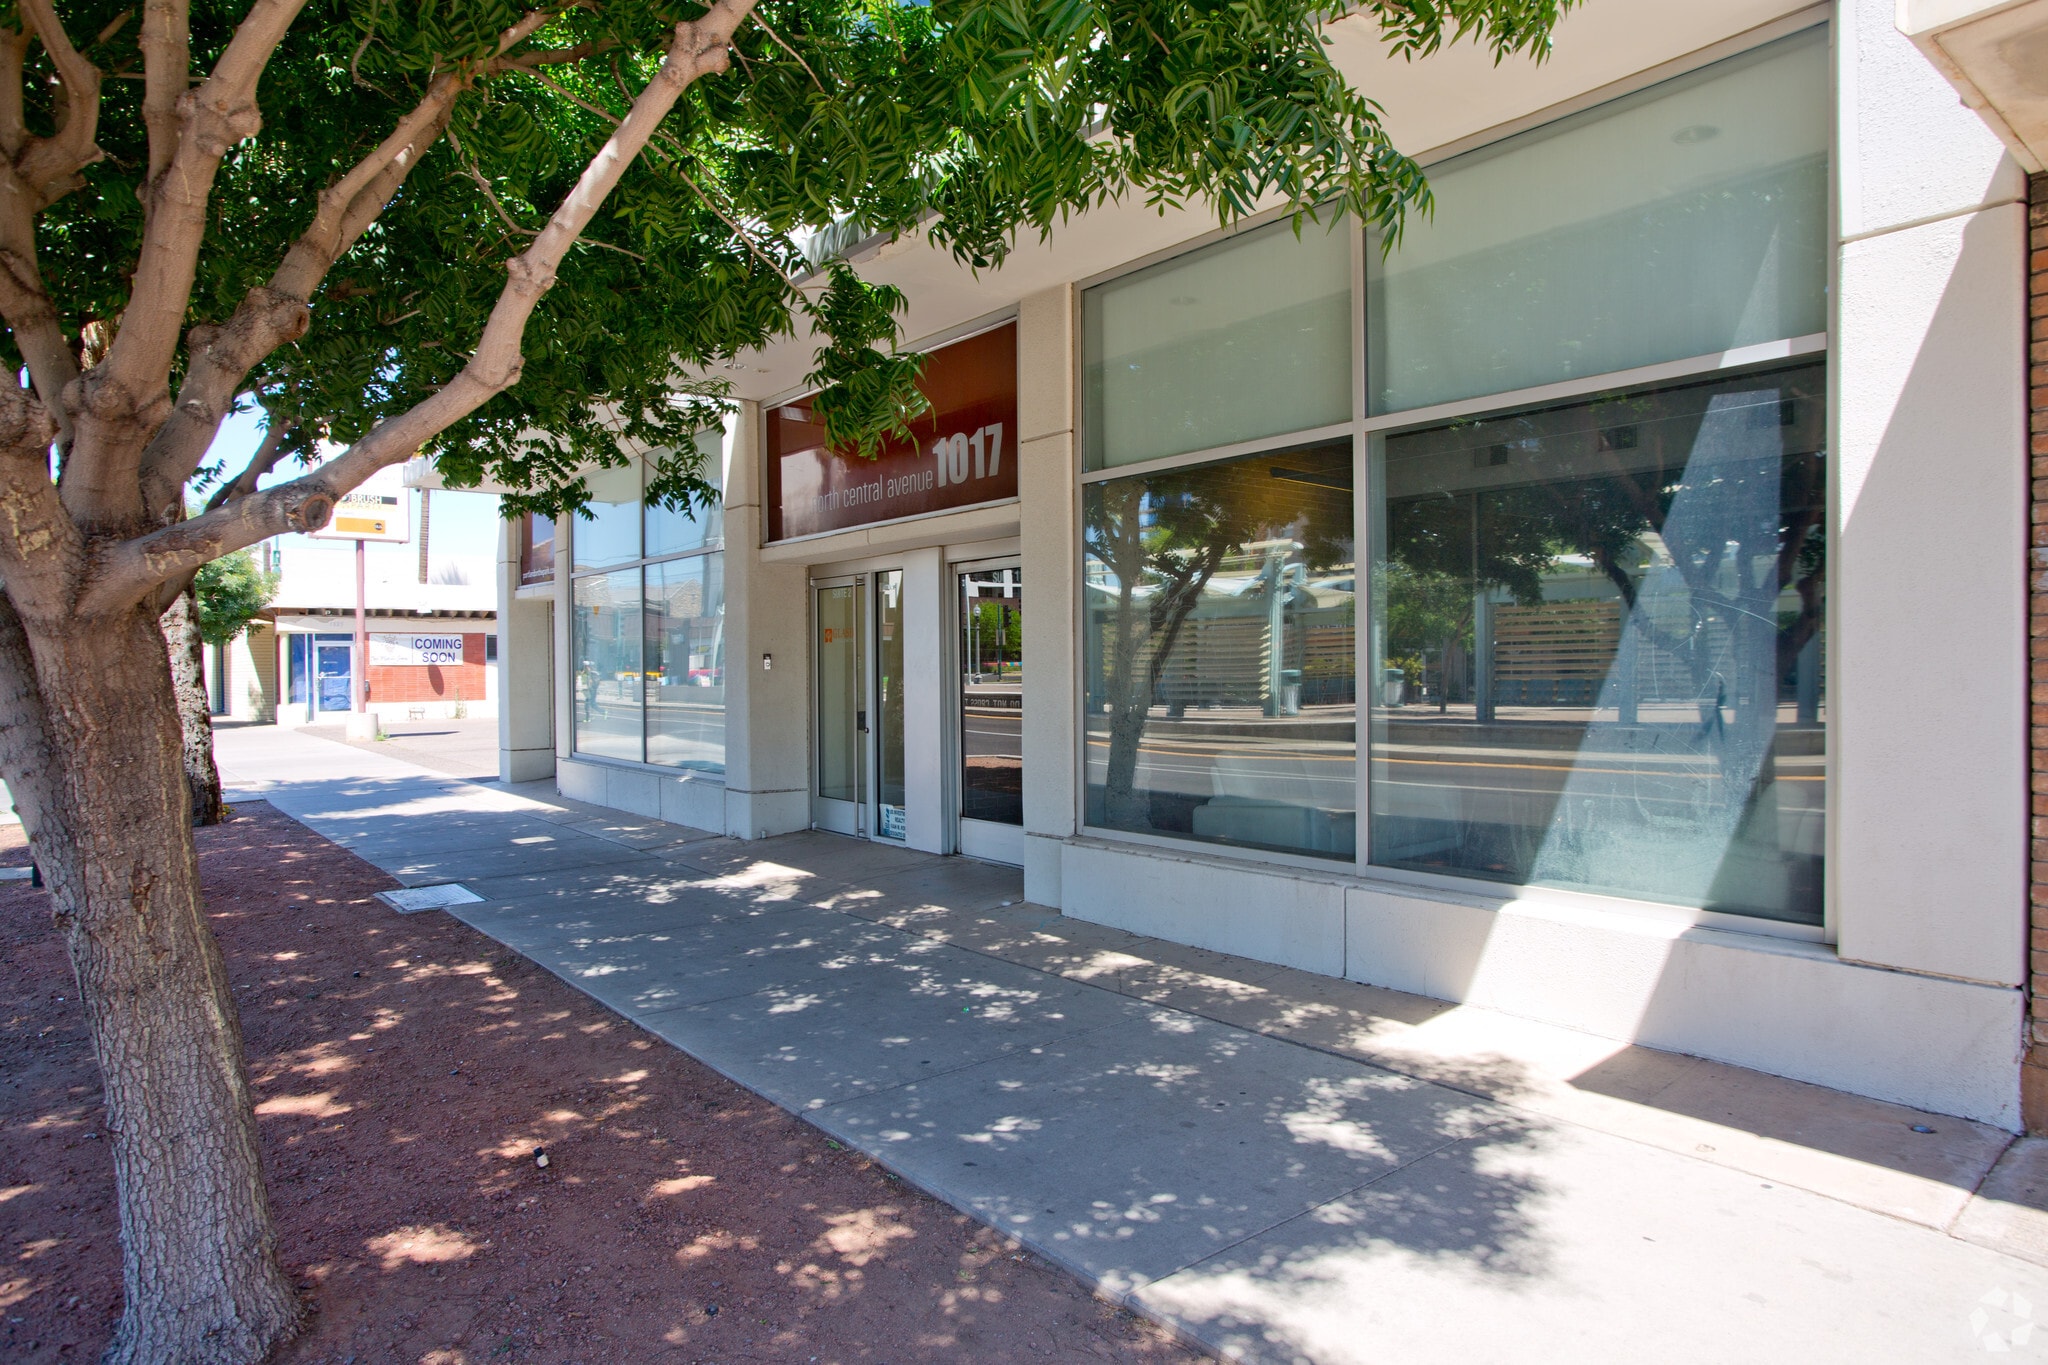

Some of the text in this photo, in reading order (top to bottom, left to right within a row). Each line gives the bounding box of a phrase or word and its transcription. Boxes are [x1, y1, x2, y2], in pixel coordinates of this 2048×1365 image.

[810, 422, 1003, 513] north central avenue 1017
[350, 494, 381, 505] BRUSH
[414, 638, 462, 650] COMING
[422, 651, 456, 663] SOON
